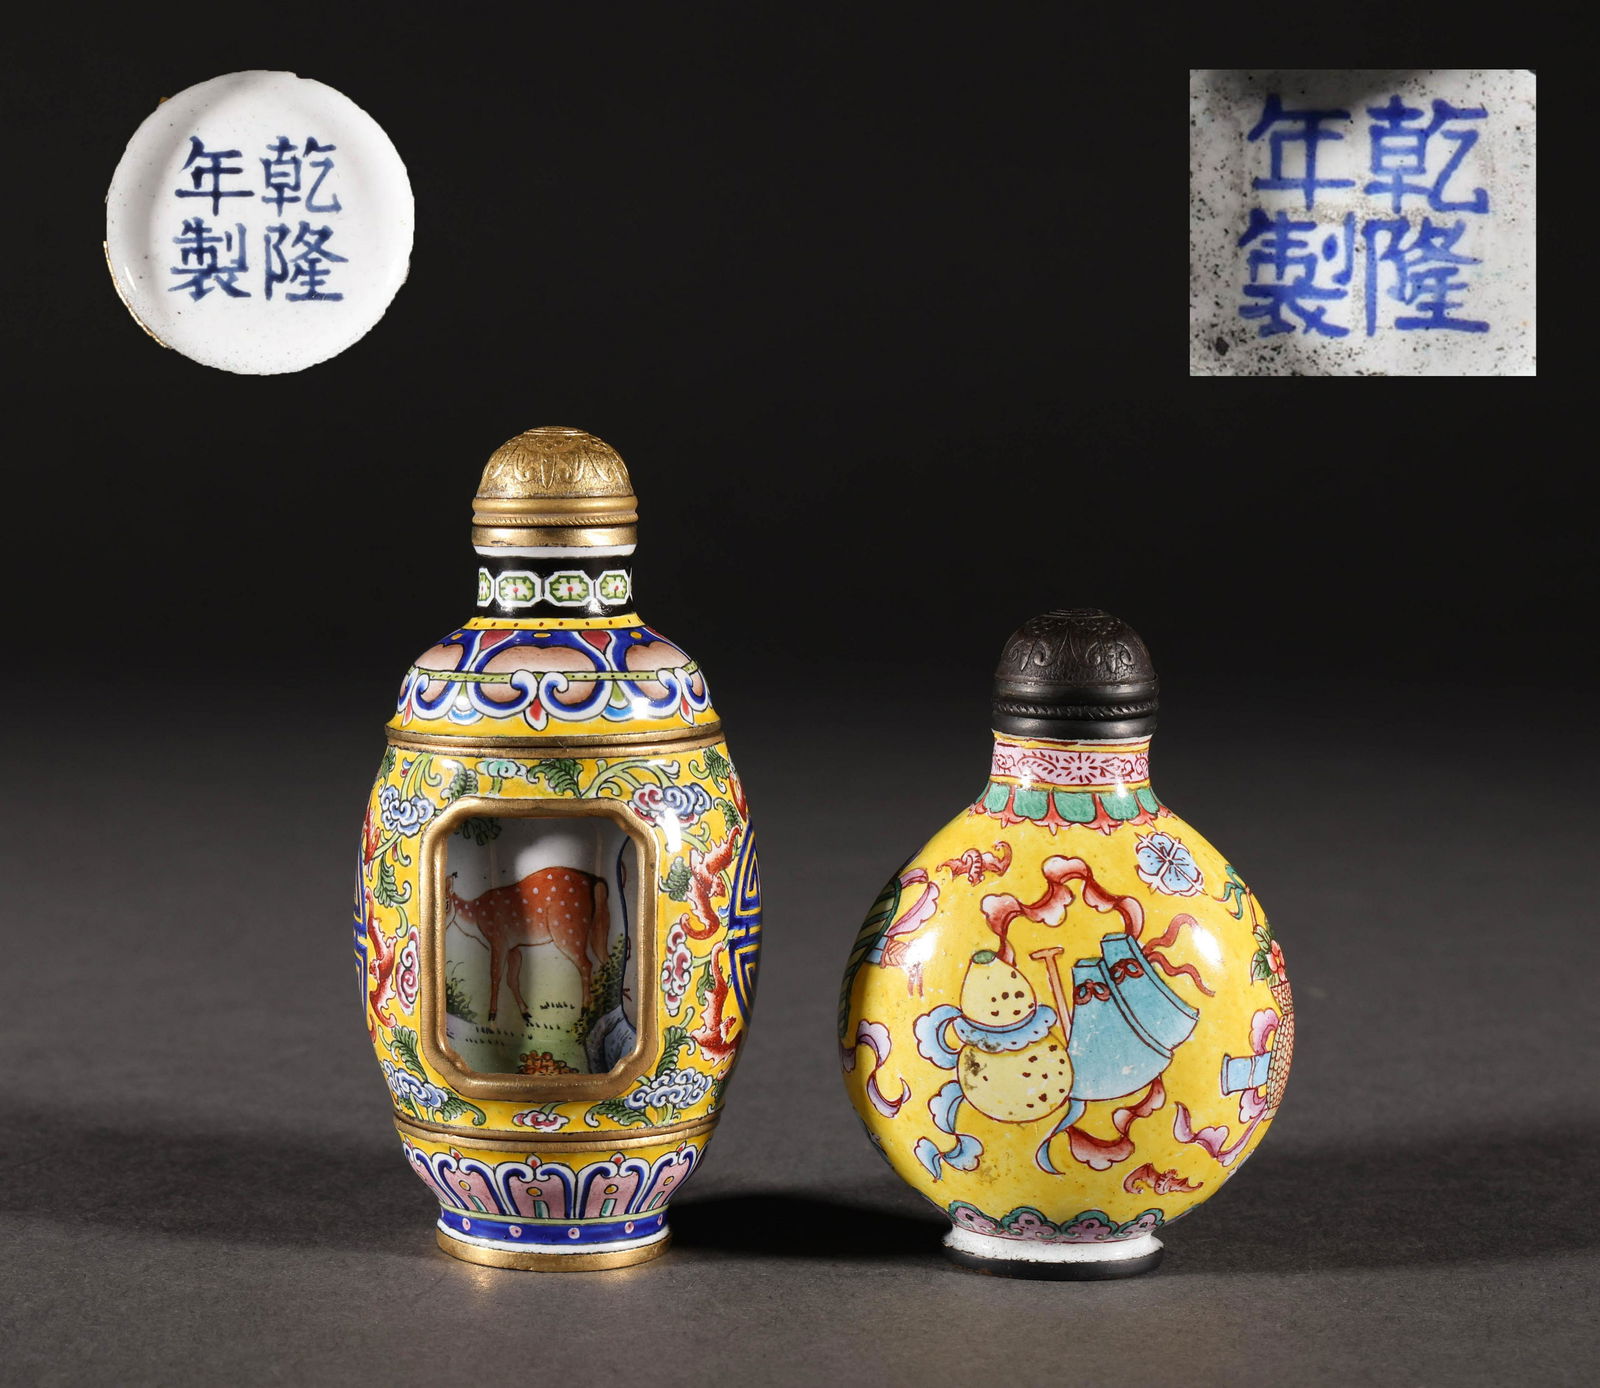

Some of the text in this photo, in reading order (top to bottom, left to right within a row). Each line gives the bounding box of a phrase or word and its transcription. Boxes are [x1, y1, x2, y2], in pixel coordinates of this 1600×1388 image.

[168, 136, 255, 302] 年製
[258, 136, 349, 302] 乾隆
[1238, 93, 1356, 338] 年製
[1361, 95, 1490, 337] 乾隆
